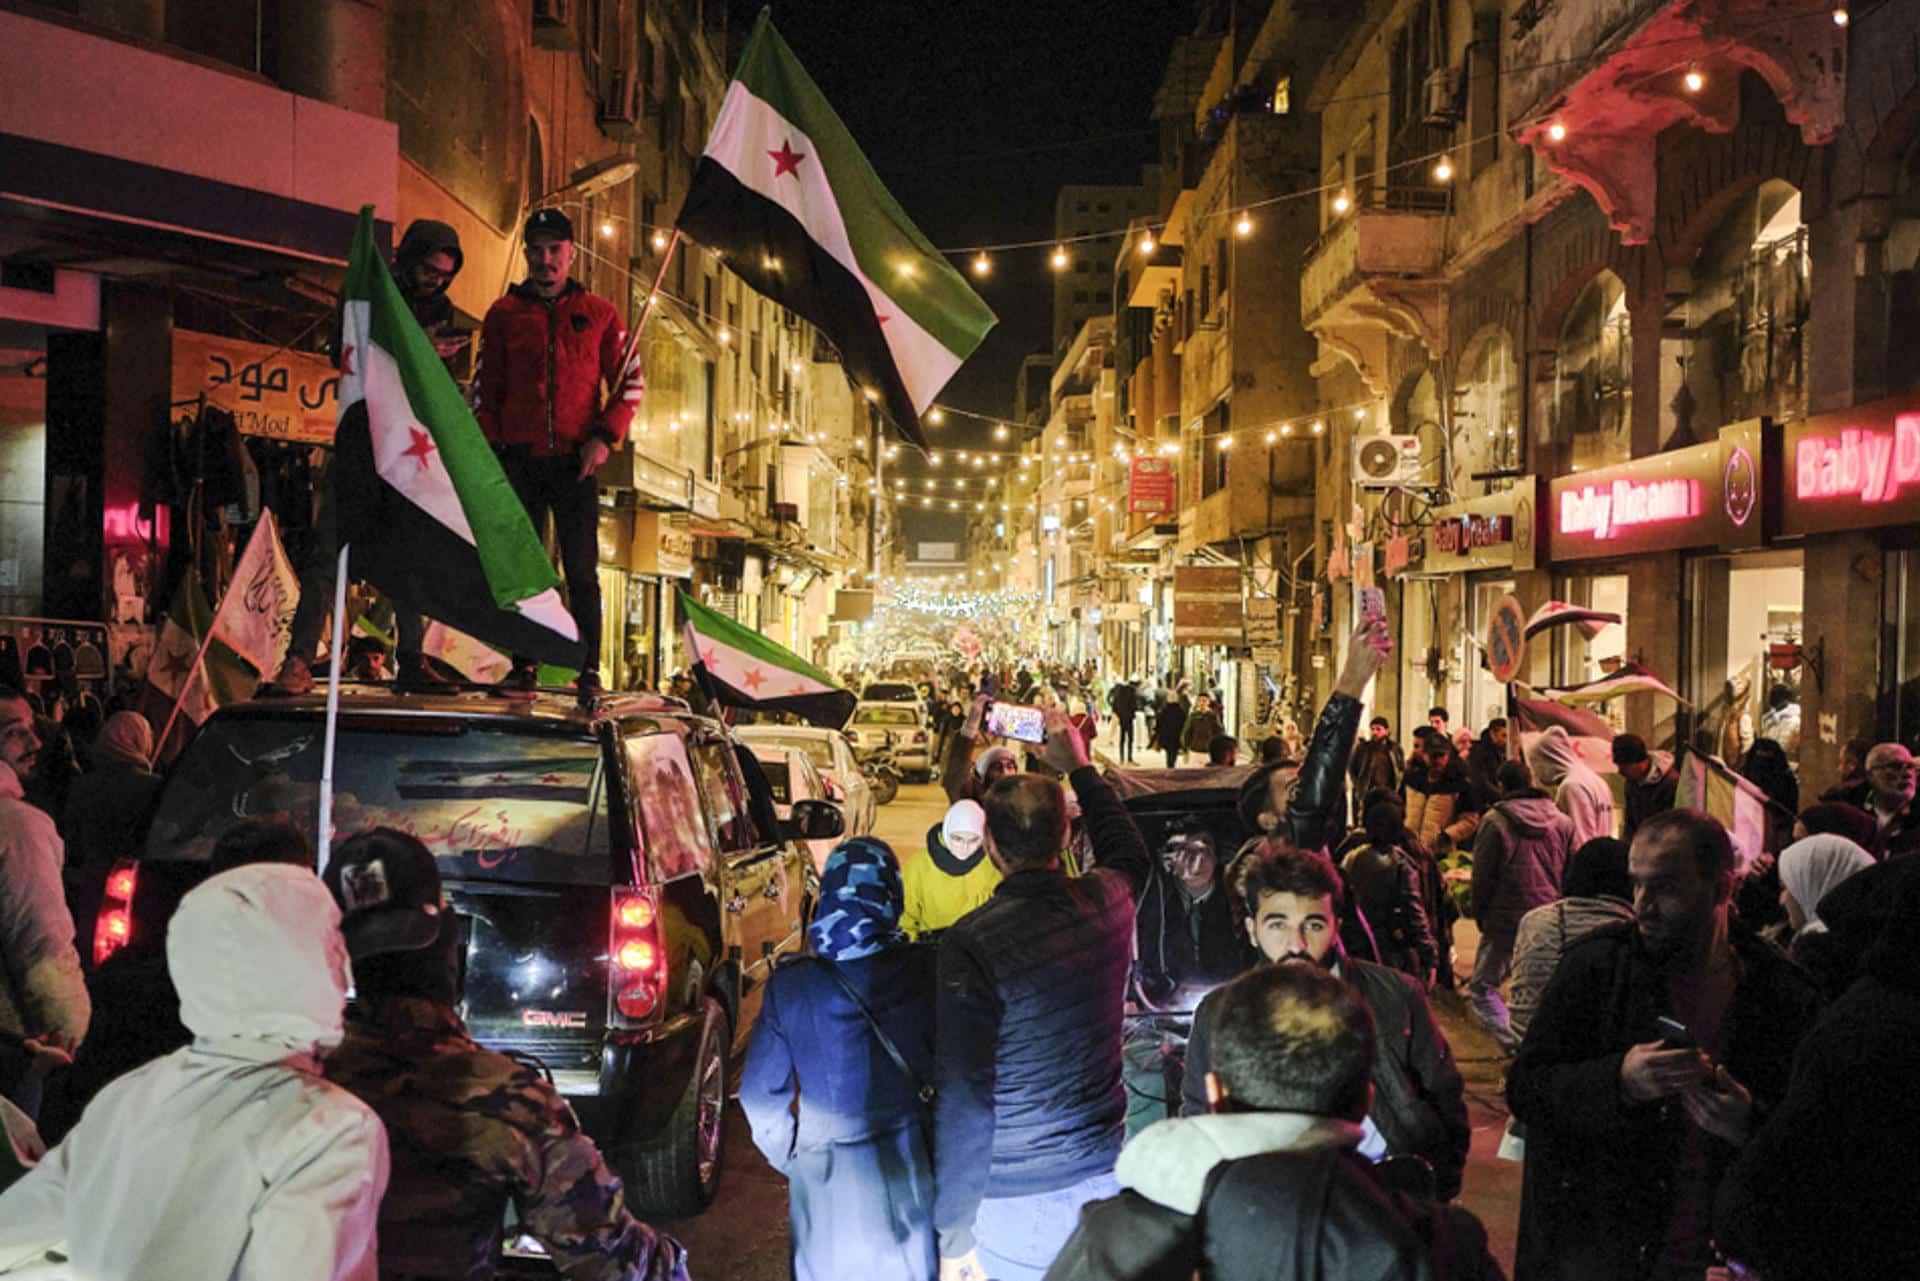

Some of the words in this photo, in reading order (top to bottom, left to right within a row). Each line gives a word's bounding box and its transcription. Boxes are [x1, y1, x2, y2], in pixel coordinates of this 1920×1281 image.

[208, 354, 288, 401] مود
[1797, 429, 1893, 502] Baby
[1895, 412, 1920, 482] D
[1560, 486, 1611, 540] Baby
[522, 1009, 587, 1028] GMC
